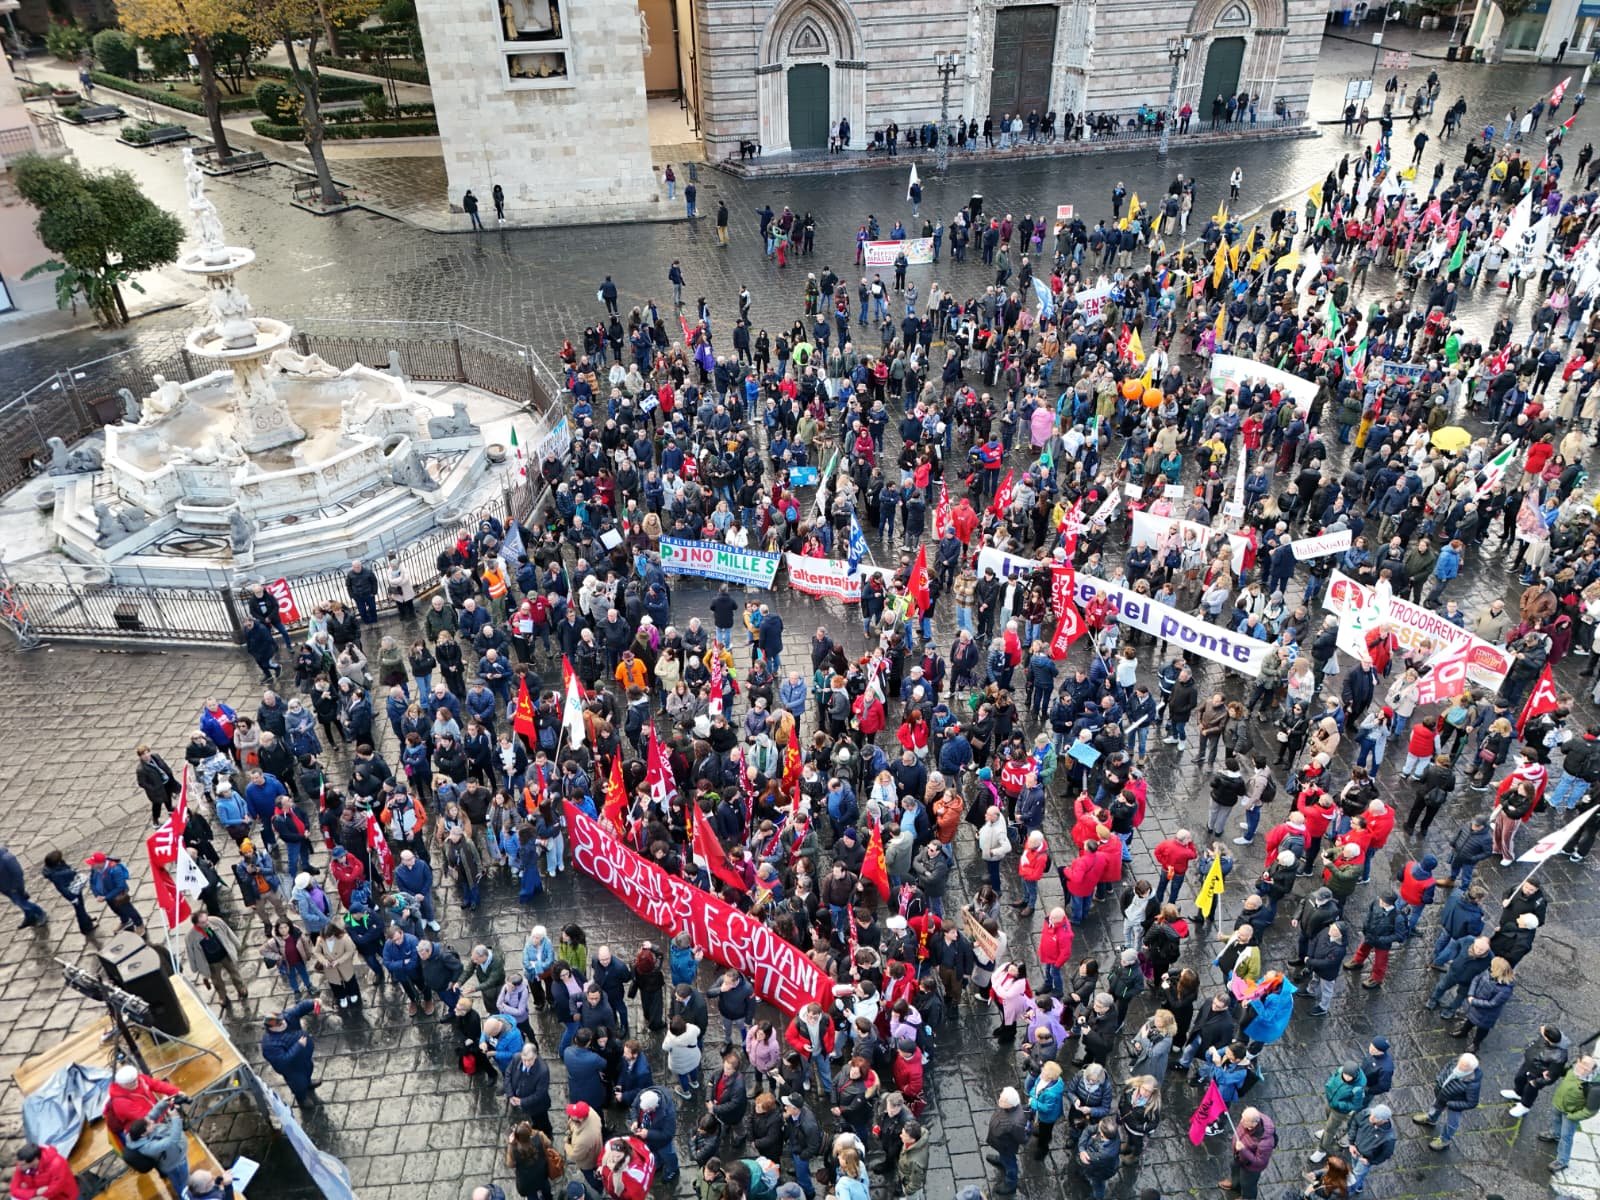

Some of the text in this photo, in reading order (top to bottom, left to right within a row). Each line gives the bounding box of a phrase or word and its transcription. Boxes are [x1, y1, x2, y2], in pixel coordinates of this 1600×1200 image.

[691, 548, 714, 563] NO
[717, 551, 761, 573] MILLE
[268, 581, 293, 614] NO
[1160, 614, 1251, 664] ponte
[574, 844, 678, 933] CONTRO
[707, 927, 798, 1013] PONTE
[726, 911, 819, 998] GIOVANI
